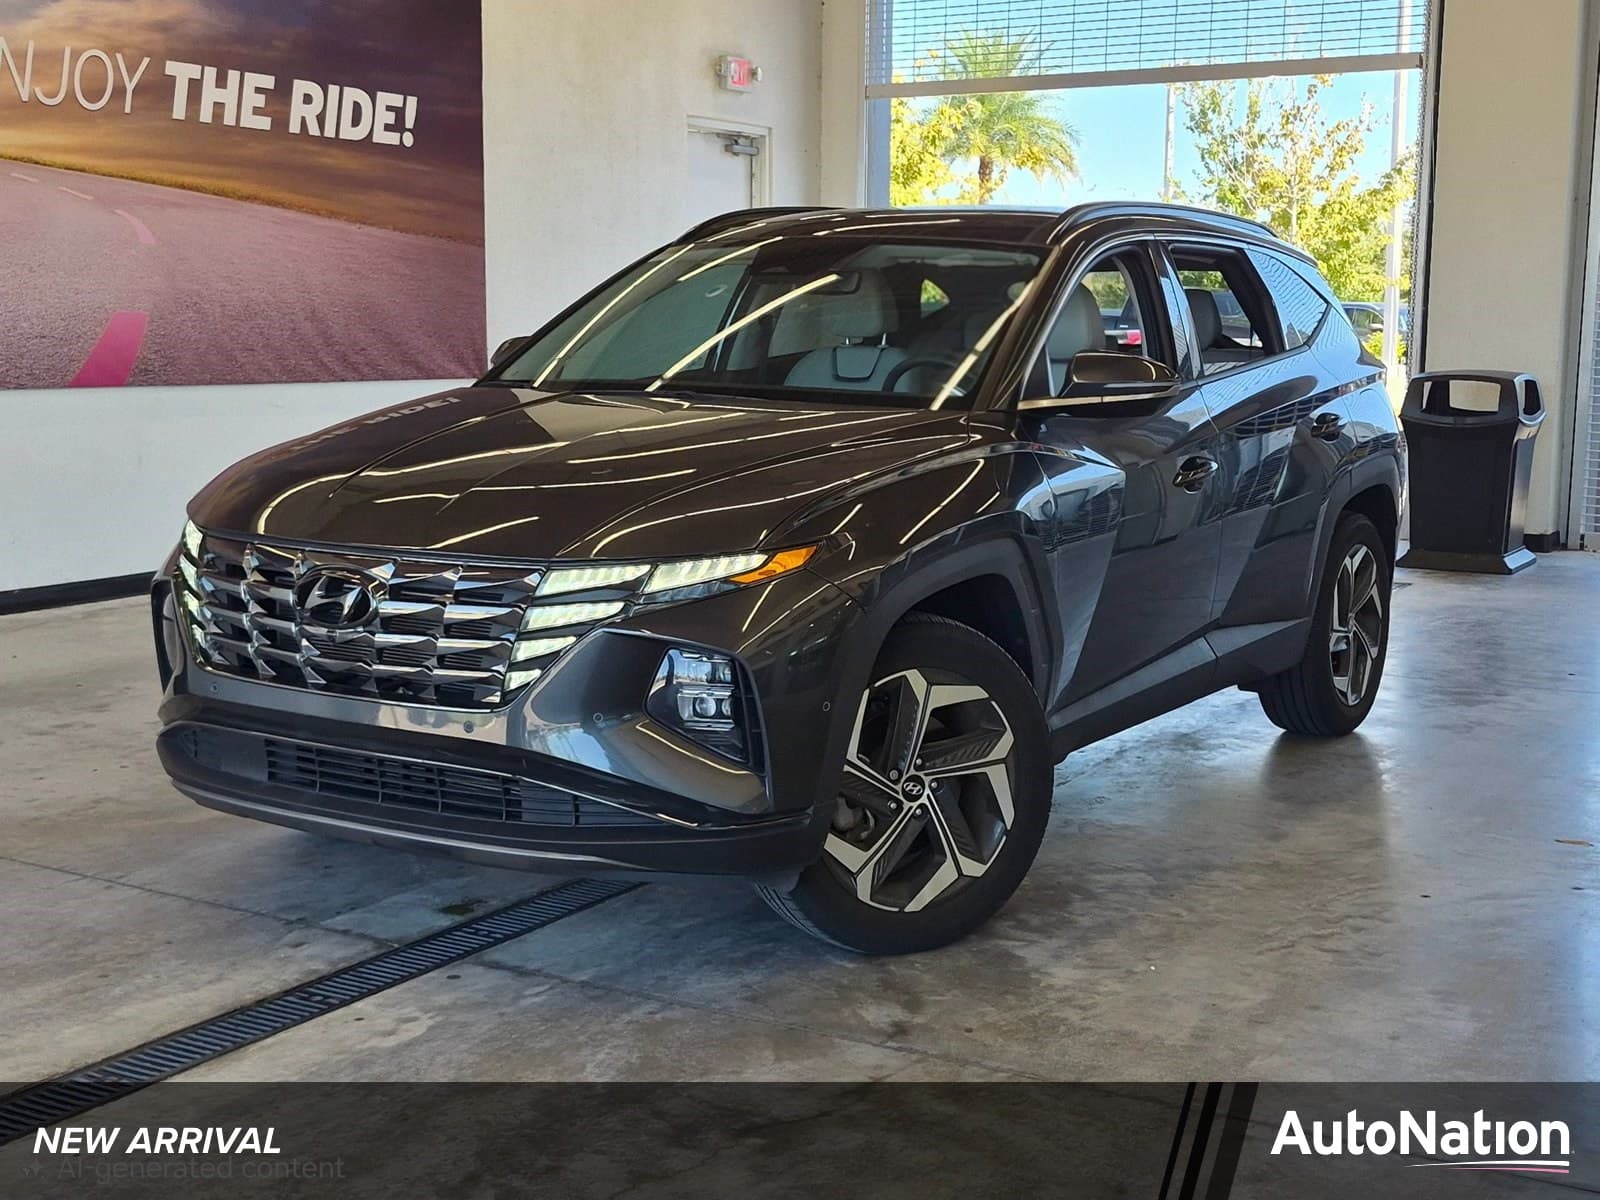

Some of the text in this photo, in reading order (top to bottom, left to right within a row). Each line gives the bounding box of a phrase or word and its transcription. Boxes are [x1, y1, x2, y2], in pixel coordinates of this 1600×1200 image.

[0, 36, 418, 148] NJOY THE RIDE!
